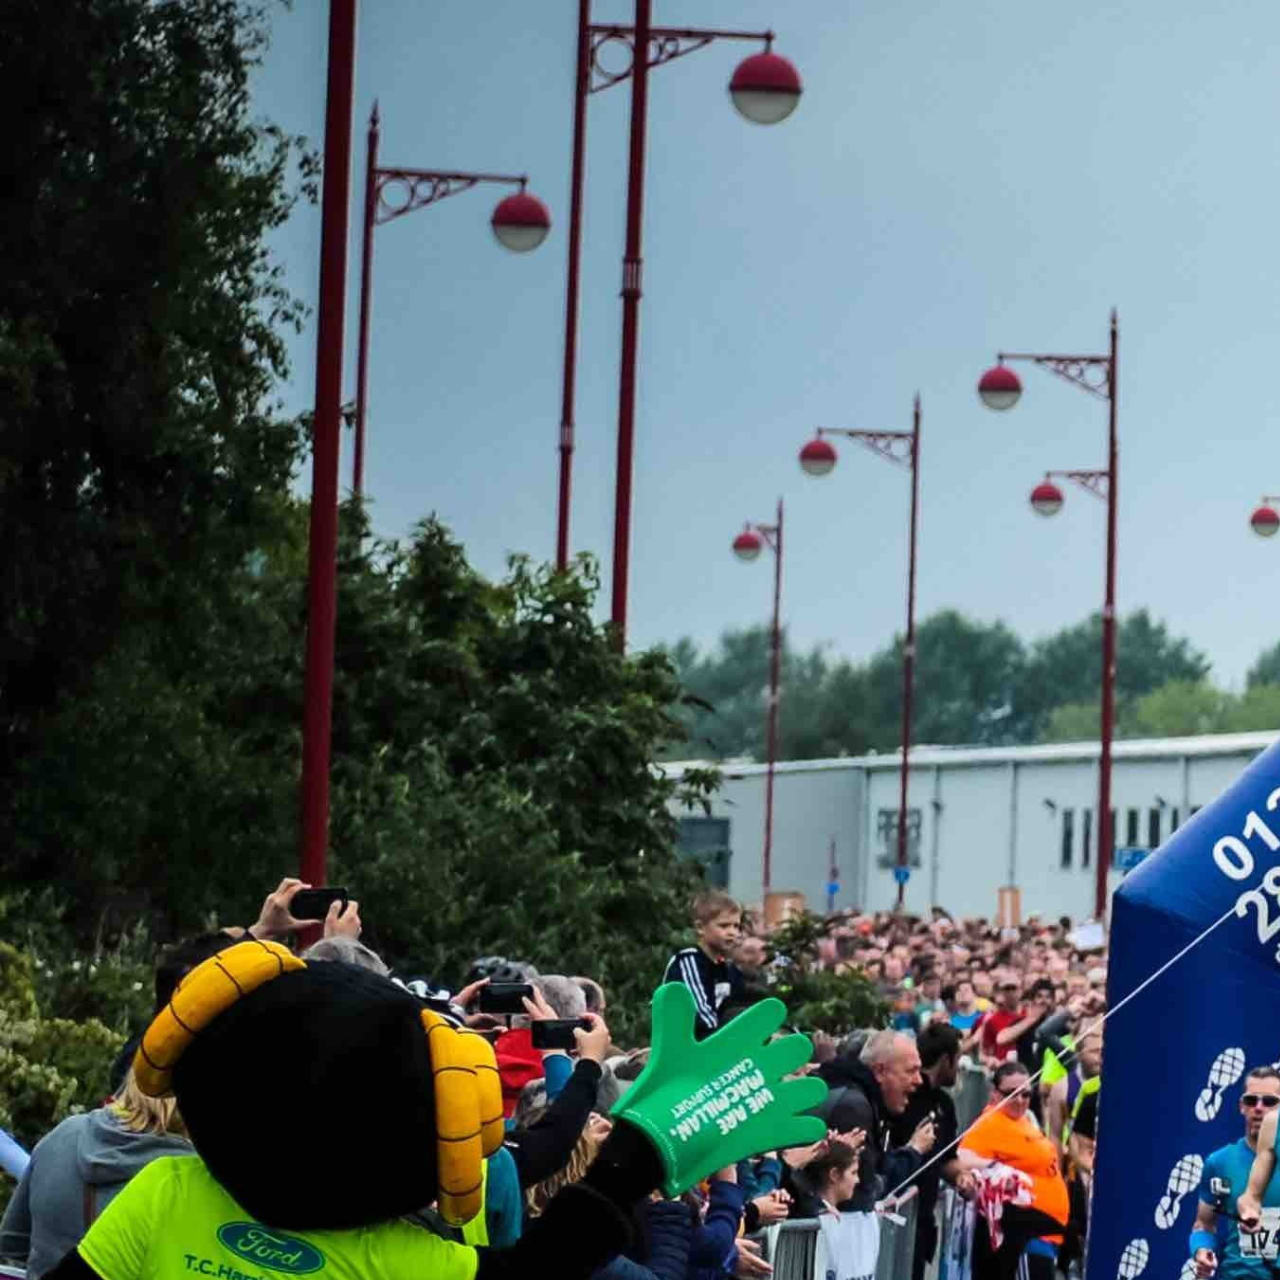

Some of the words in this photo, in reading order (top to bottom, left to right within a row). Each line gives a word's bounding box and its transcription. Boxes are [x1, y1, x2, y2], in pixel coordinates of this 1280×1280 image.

[711, 1057, 754, 1091] CANCER
[671, 1083, 714, 1119] SUPPORT
[744, 1087, 775, 1115] WE
[715, 1104, 748, 1136] ARE
[237, 1229, 303, 1267] Ford
